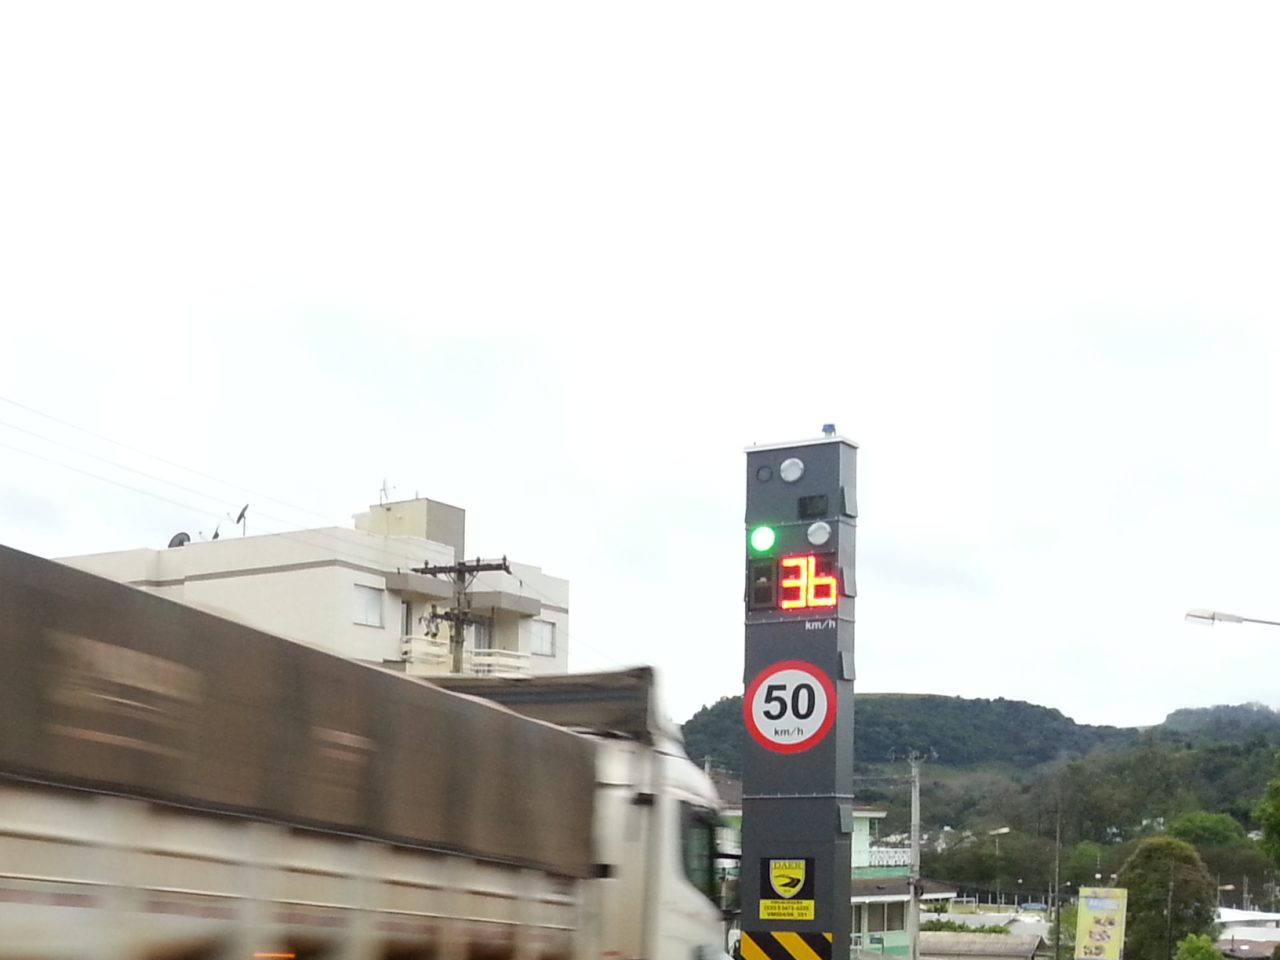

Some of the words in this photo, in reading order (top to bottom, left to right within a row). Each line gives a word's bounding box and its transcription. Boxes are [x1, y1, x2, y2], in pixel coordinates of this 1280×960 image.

[781, 555, 836, 609] 36
[805, 620, 836, 630] km/h
[763, 683, 816, 720] 50
[774, 726, 804, 737] km/h
